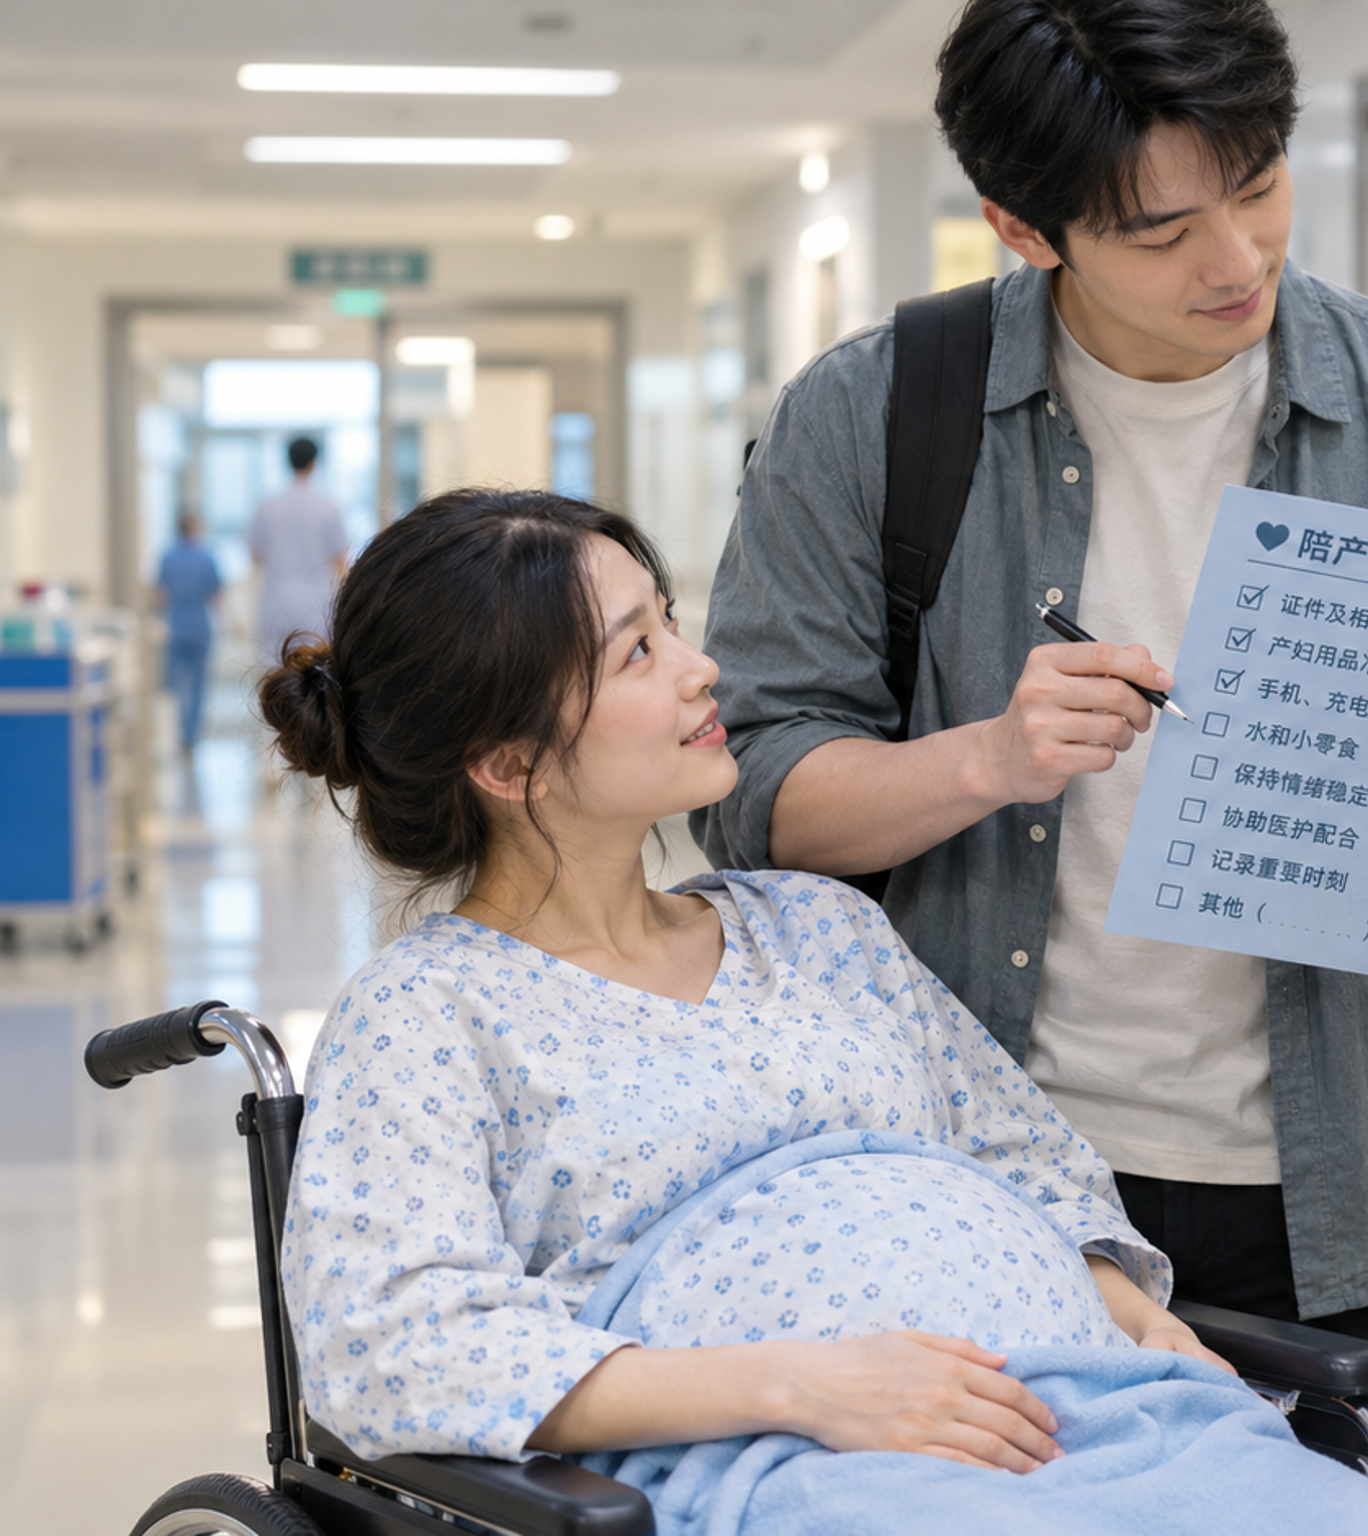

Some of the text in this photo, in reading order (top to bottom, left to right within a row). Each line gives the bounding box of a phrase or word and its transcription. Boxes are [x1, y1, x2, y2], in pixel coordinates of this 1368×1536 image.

[1244, 720, 1360, 761] 水和小零食
[1222, 805, 1360, 850] 协助医护配合
[1211, 848, 1350, 894] 记录重要时刻
